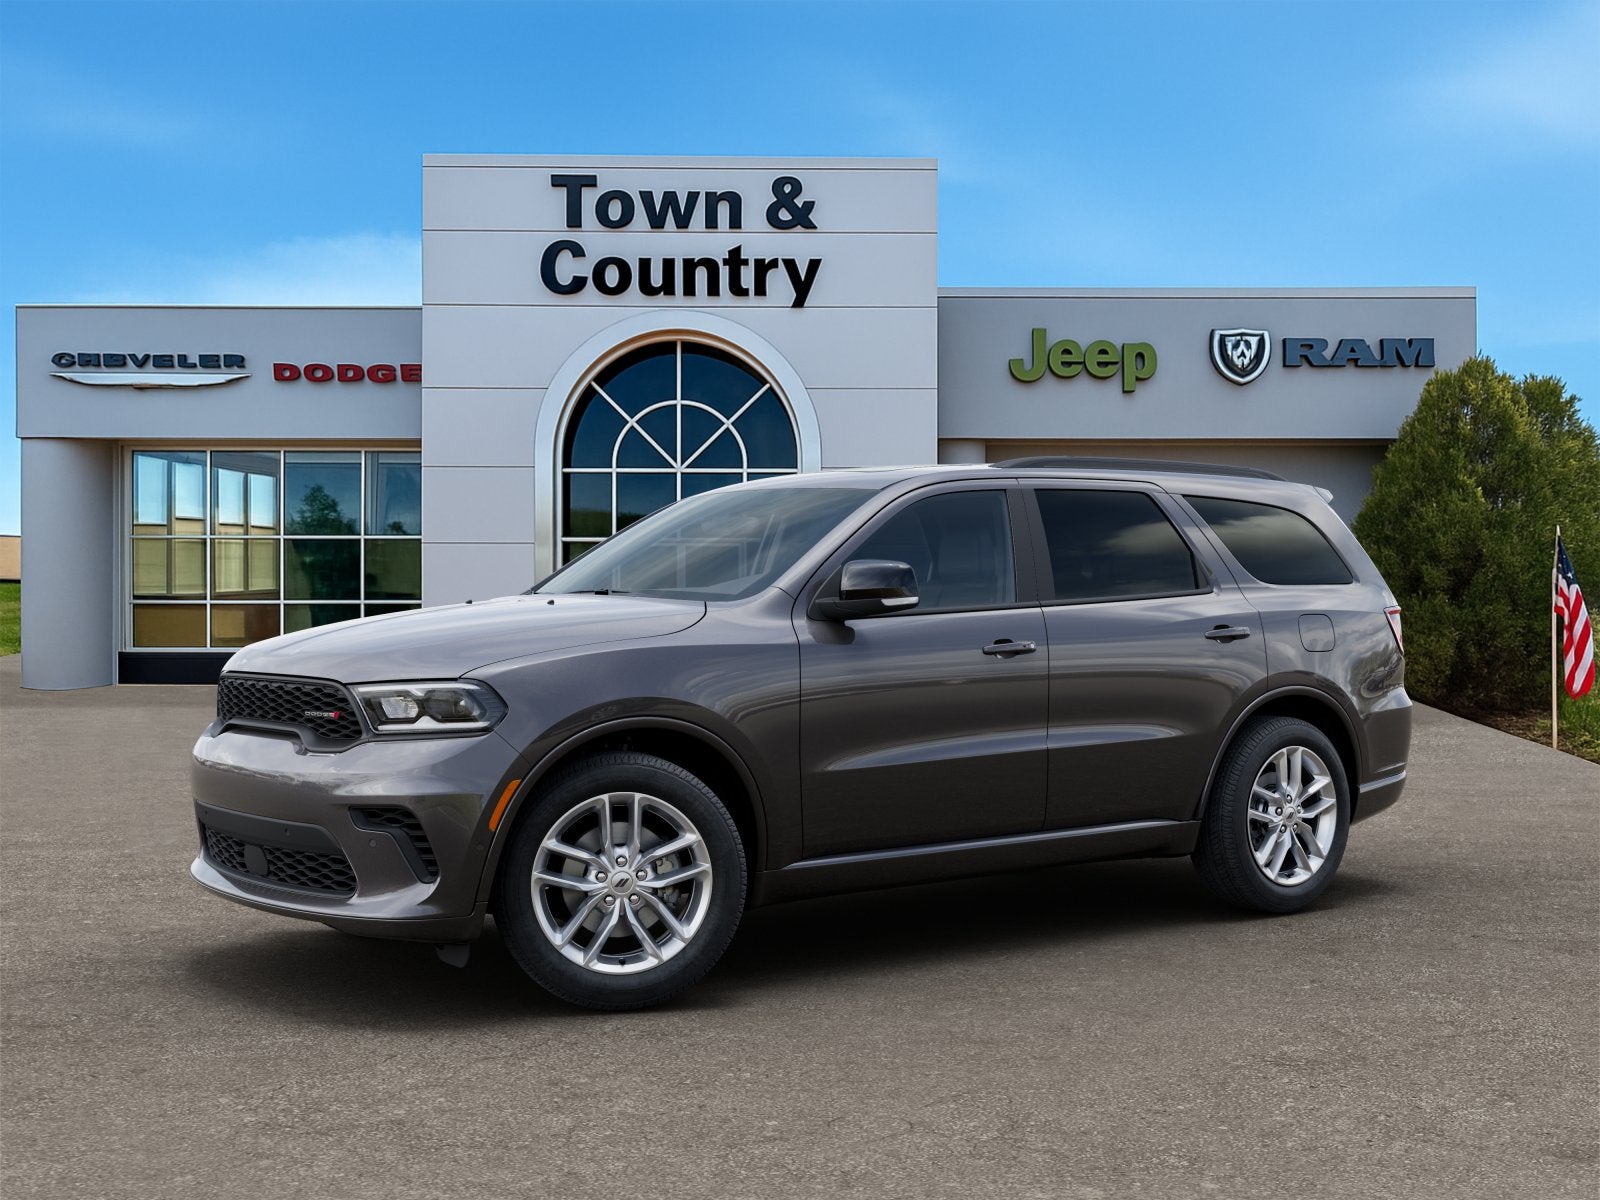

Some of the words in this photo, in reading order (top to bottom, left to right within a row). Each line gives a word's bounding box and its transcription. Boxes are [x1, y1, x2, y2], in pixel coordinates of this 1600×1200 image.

[550, 174, 742, 229] Town
[766, 176, 818, 229] &
[540, 239, 822, 308] Country
[273, 362, 422, 383] DODGE
[1009, 328, 1157, 393] Jeep
[1282, 337, 1435, 368] RAM
